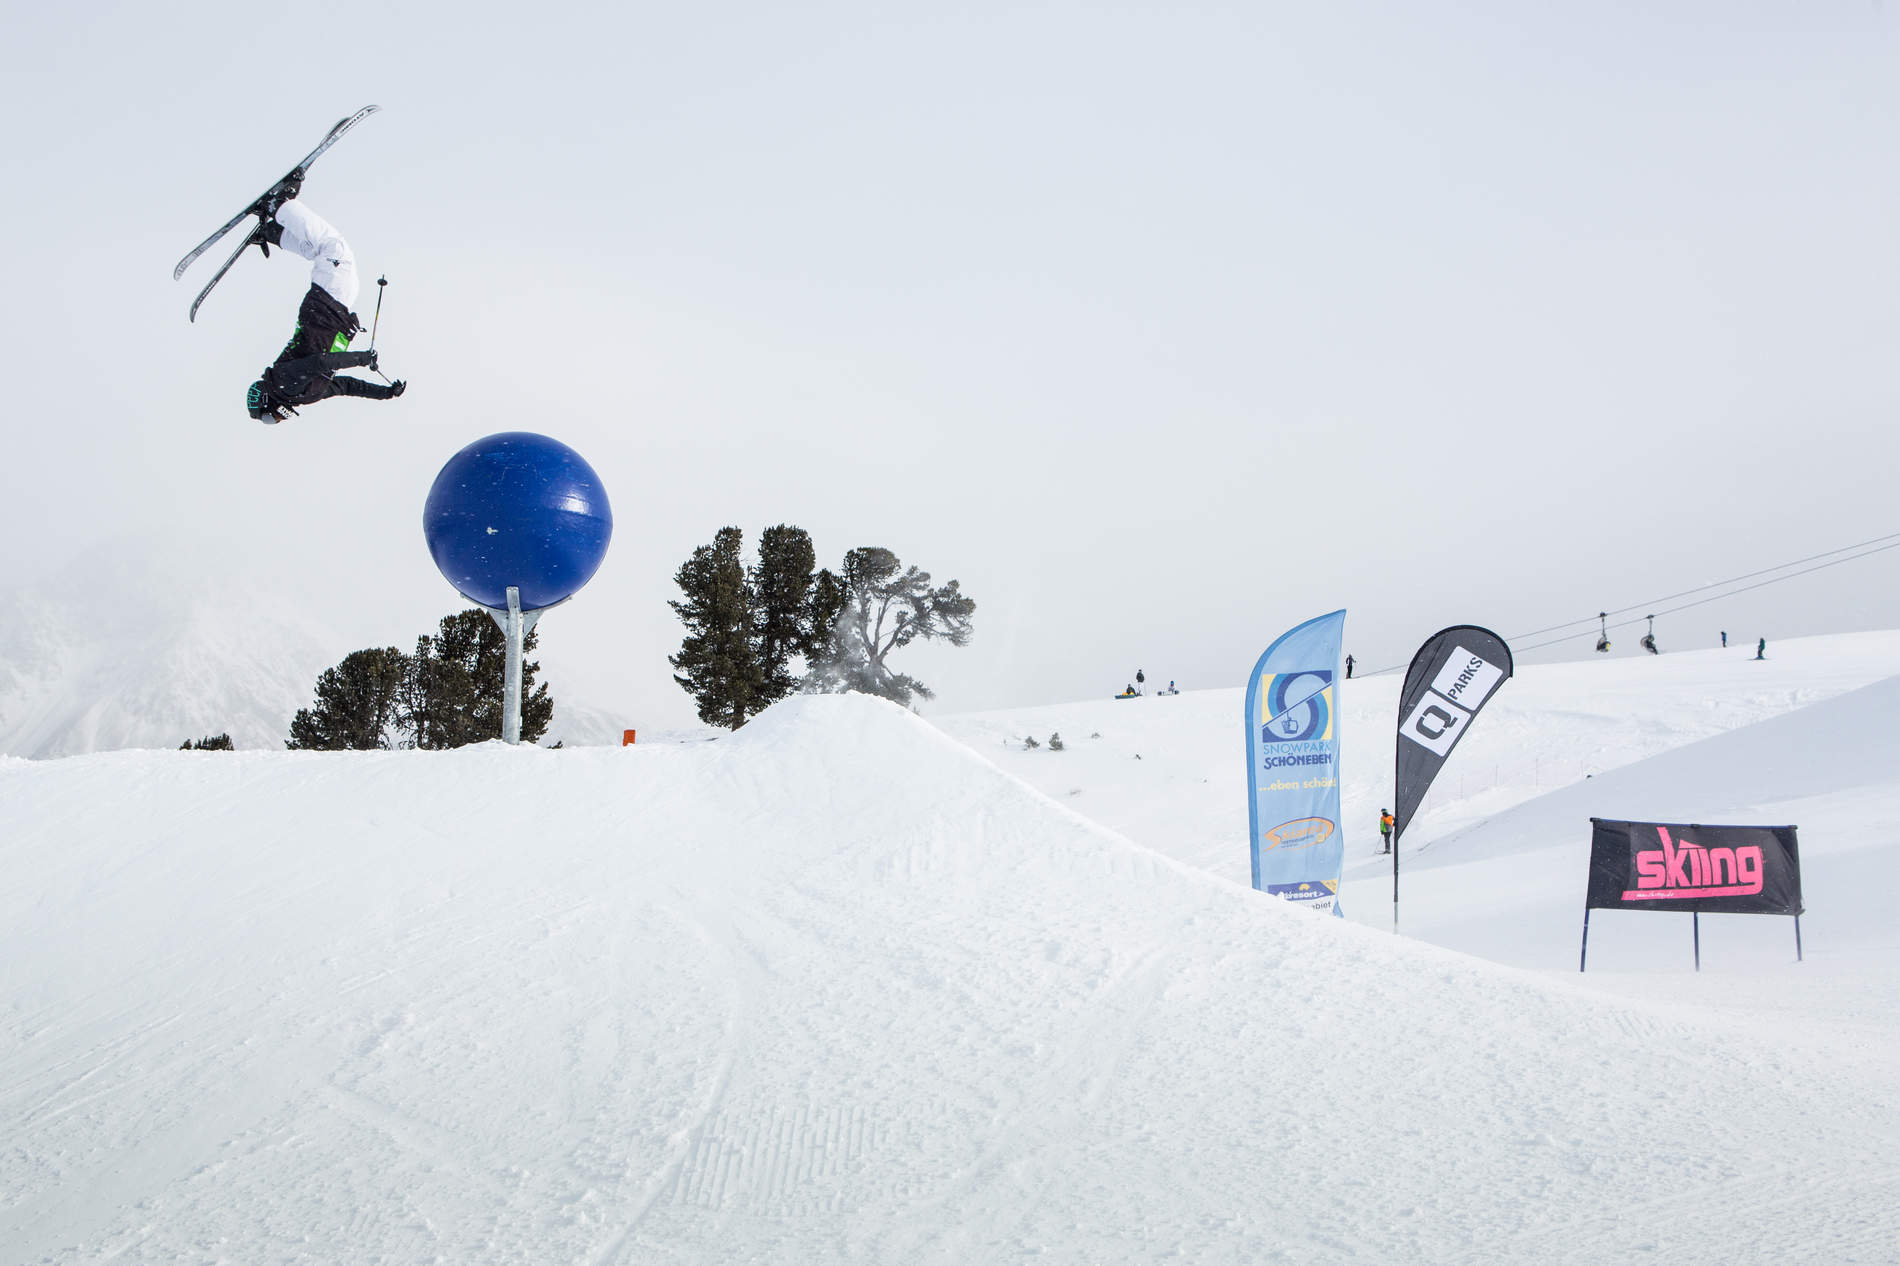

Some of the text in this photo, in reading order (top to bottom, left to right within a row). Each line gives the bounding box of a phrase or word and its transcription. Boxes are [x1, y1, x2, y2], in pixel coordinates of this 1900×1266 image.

[1415, 656, 1483, 740] Q PARKS
[1263, 742, 1331, 755] SNOWPARK
[1263, 753, 1332, 770] SCHÖNEBEN
[1632, 827, 1764, 896] skiing
